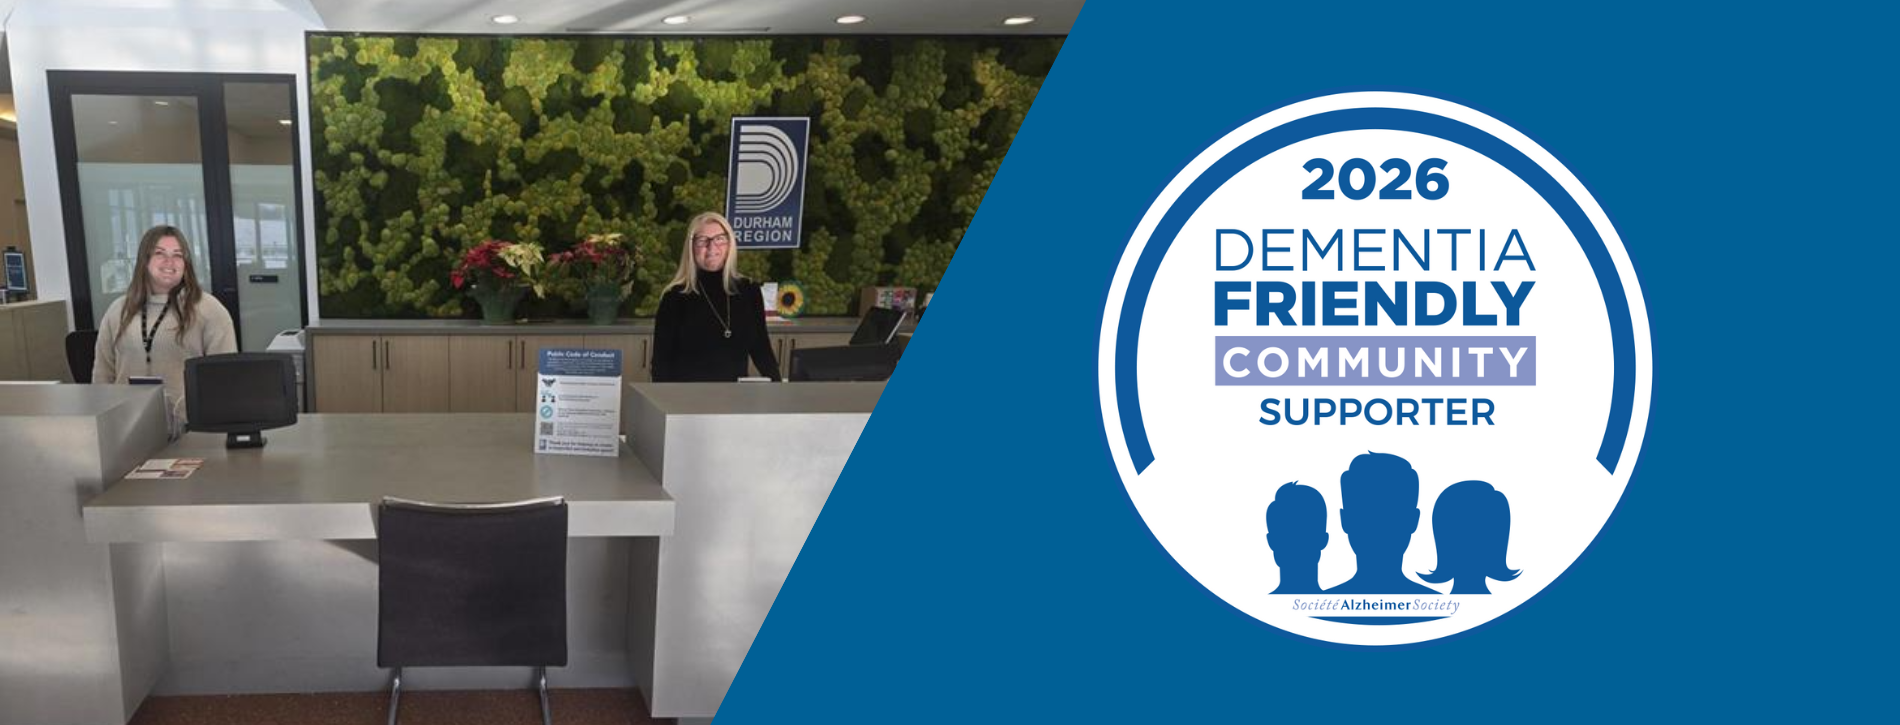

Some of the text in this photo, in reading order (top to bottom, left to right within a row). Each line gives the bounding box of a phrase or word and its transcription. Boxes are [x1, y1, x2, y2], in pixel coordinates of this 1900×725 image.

[733, 216, 793, 229] DURHAM
[733, 229, 792, 242] REGION
[547, 350, 564, 358] Public
[590, 351, 615, 359] Conduct
